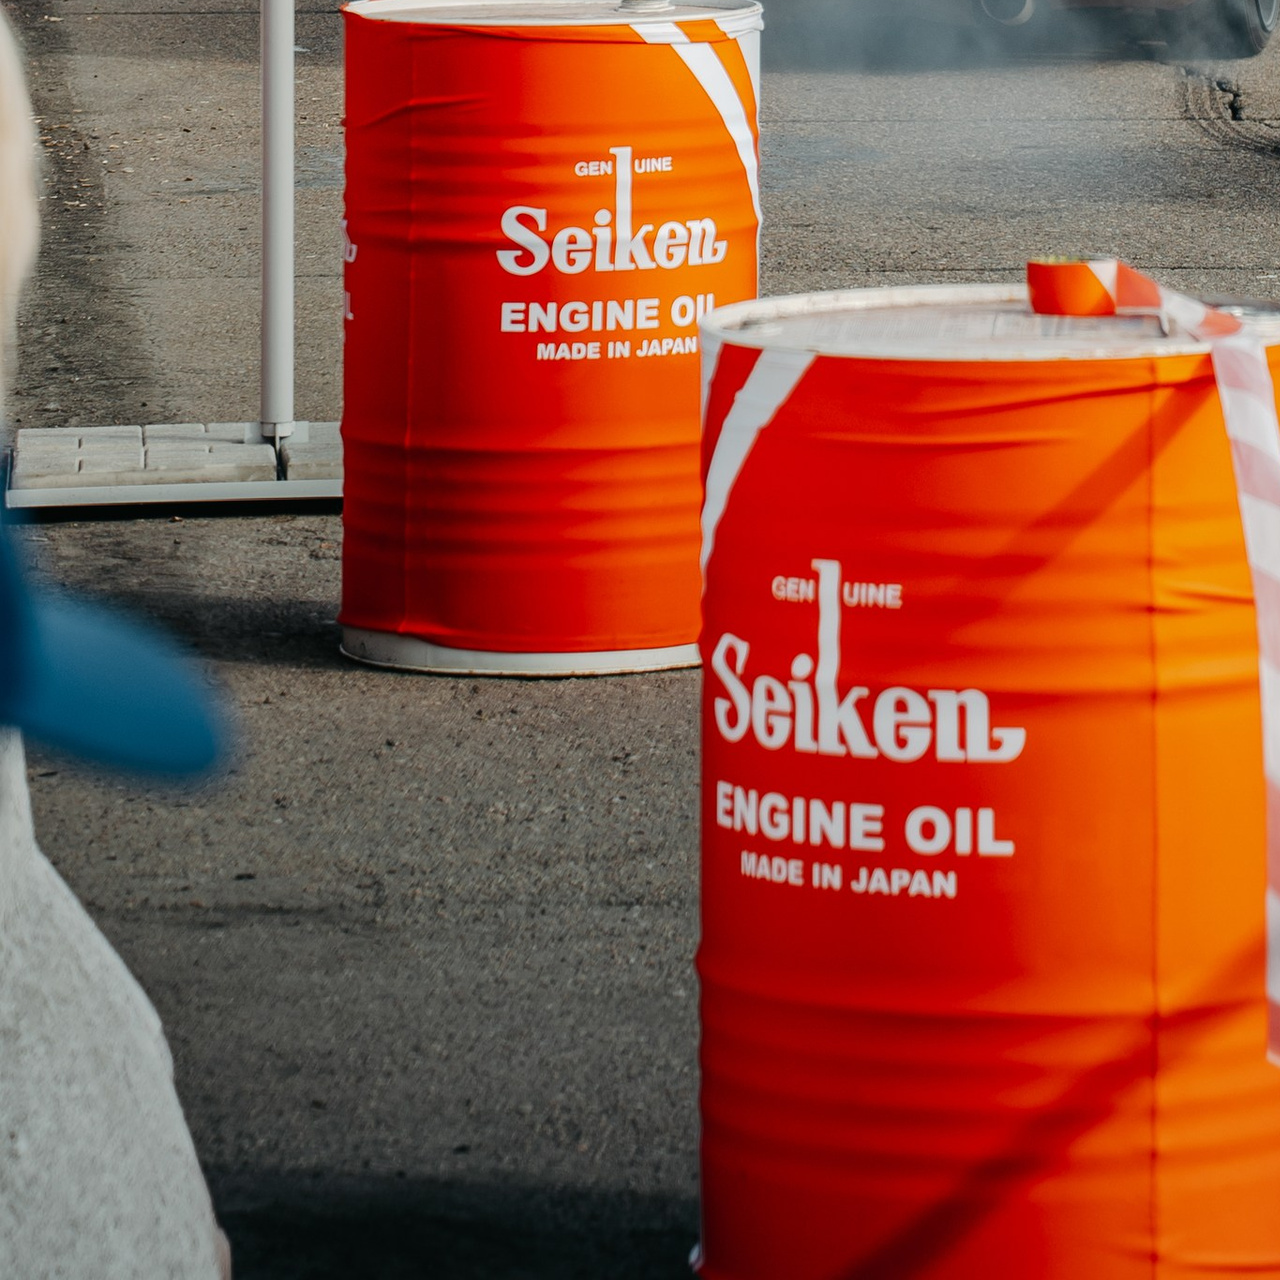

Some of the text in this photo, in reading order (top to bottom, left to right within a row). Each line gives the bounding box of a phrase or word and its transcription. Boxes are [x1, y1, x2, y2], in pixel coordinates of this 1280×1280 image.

[496, 146, 728, 276] Seiken
[500, 297, 661, 333] ENGINE
[536, 336, 698, 361] MADE IN JAPAN
[711, 558, 1027, 764] Seiken
[716, 780, 1016, 858] ENGINE OIL
[740, 849, 958, 900] MADE IN JAPAN
